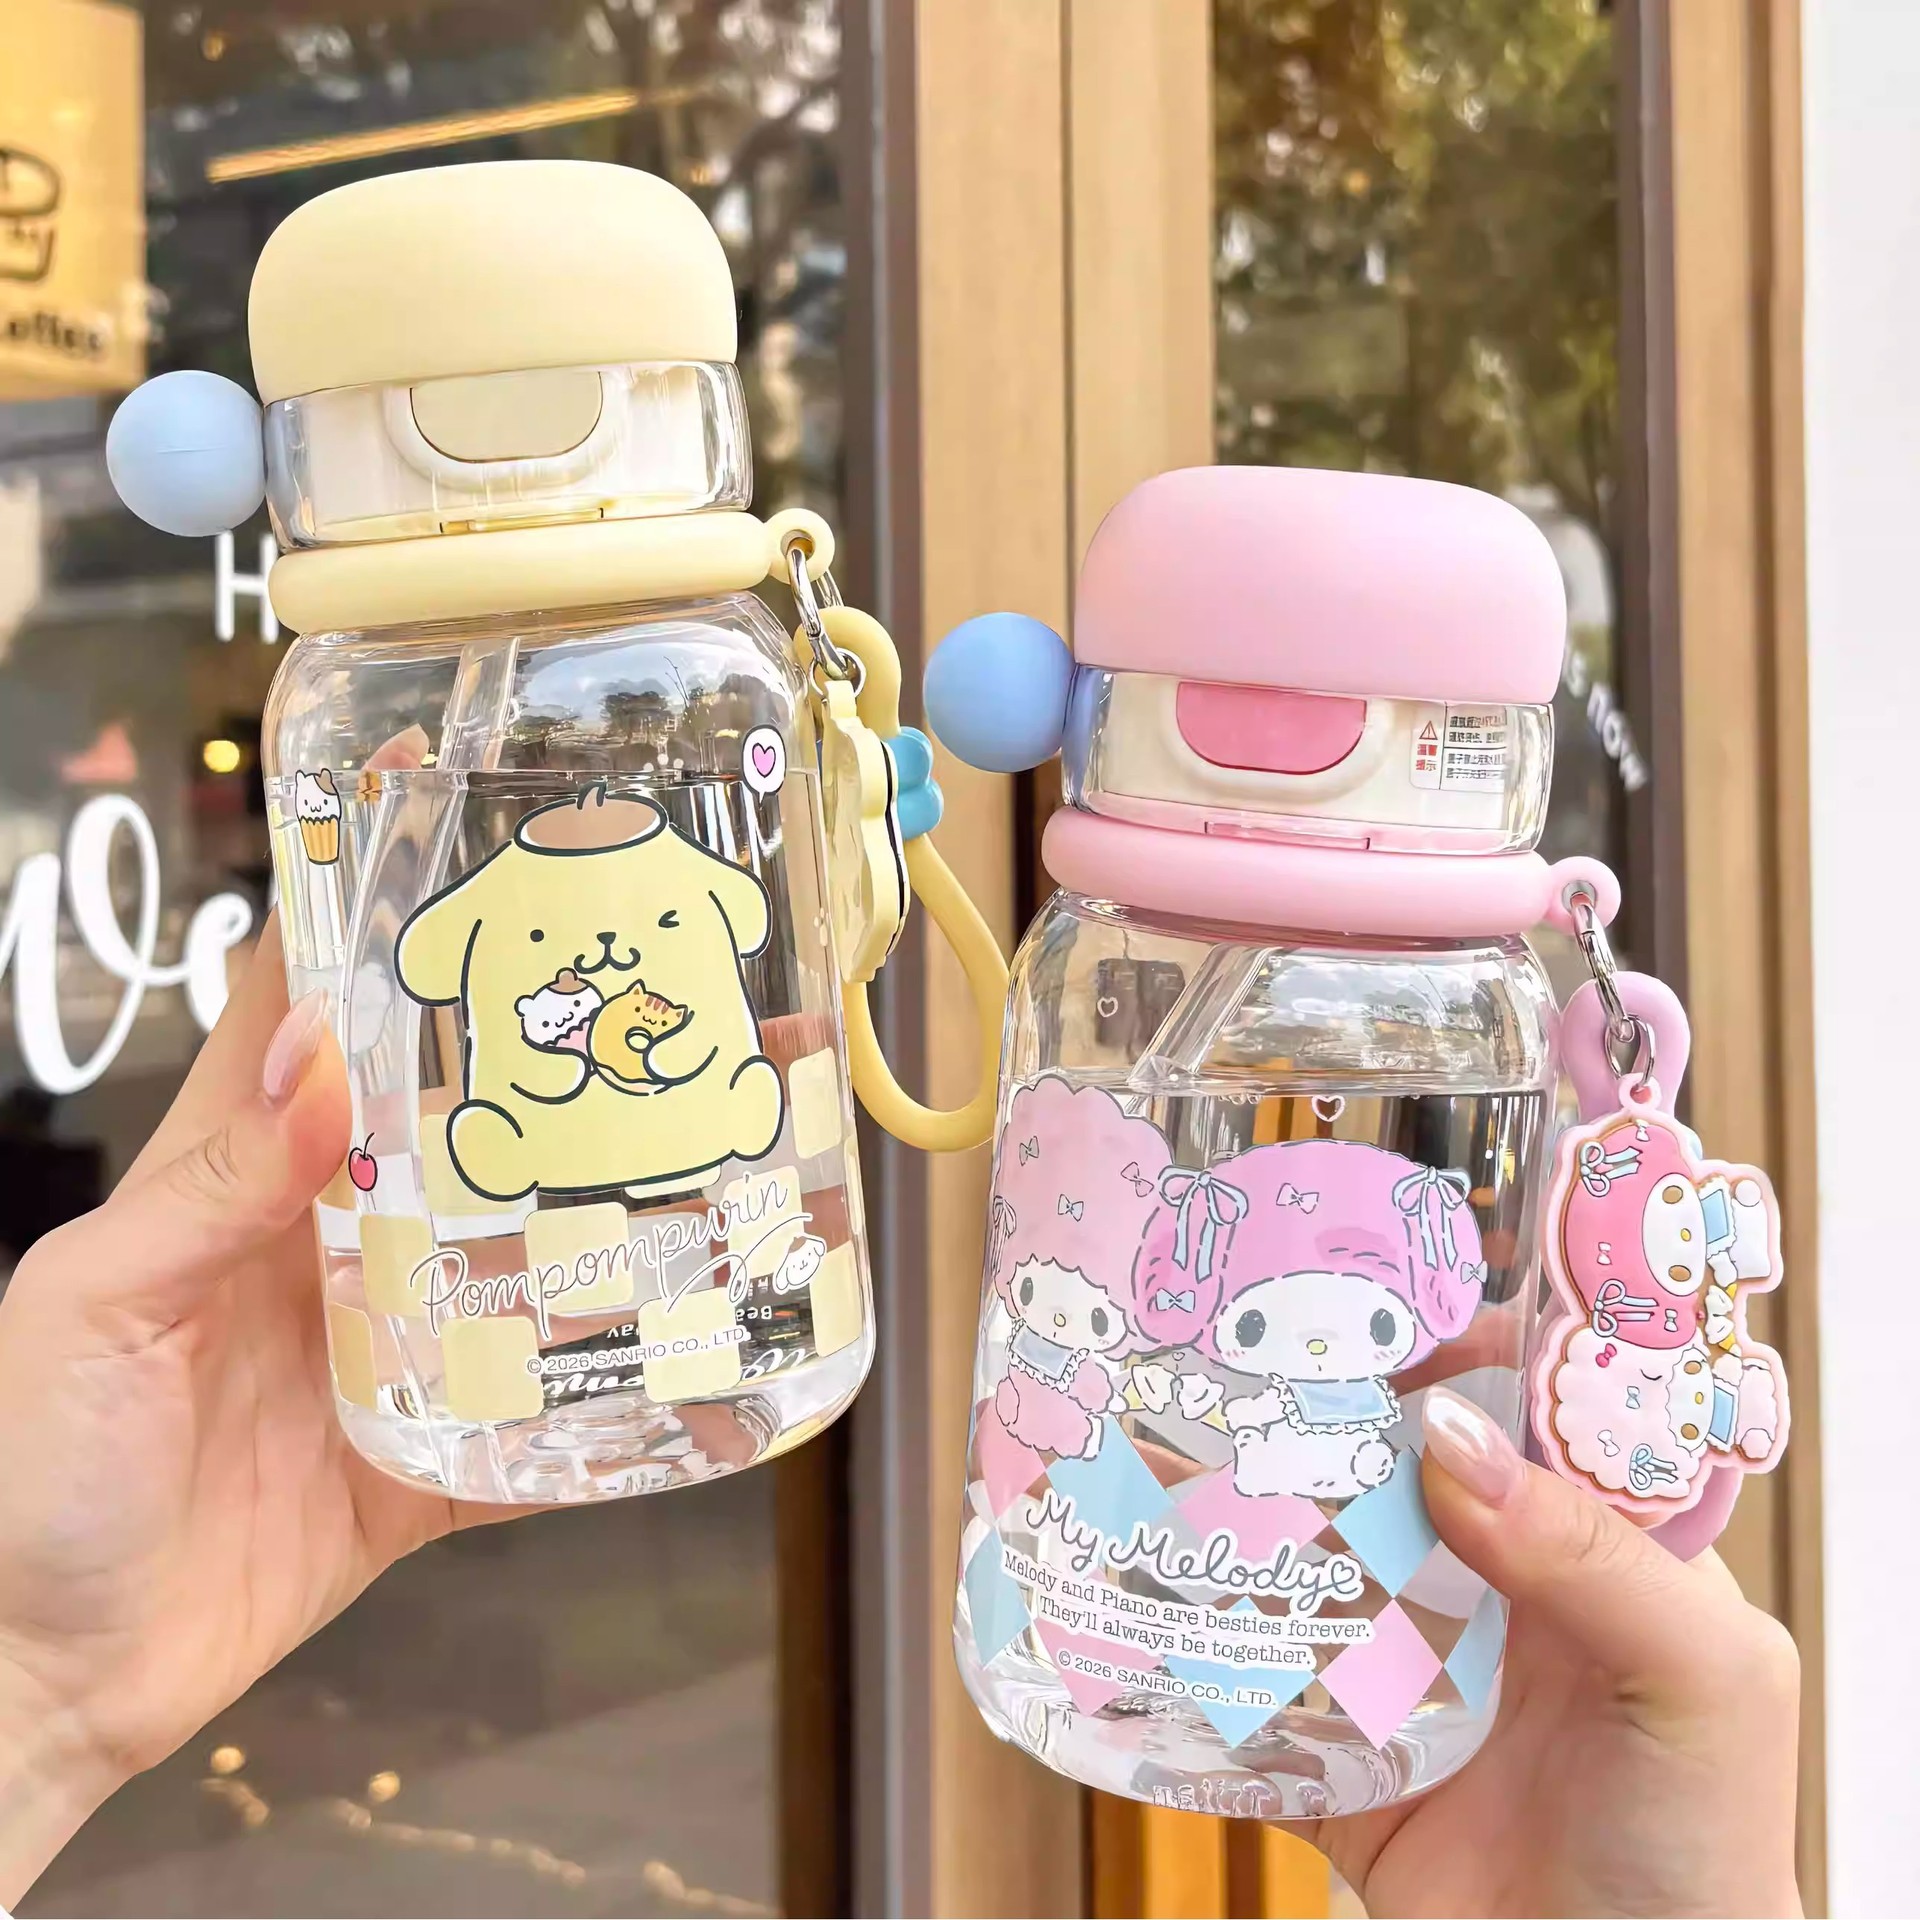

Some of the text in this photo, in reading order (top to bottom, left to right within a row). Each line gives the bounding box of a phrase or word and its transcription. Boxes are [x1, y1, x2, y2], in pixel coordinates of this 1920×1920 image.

[410, 1174, 790, 1340] Pompompurin
[547, 1355, 589, 1372] 2026
[594, 1344, 667, 1366] SANRIO
[672, 1338, 709, 1355] CO.,
[1025, 1494, 1322, 1612] My Melody
[1004, 1550, 1371, 1638] Melody and Piano are besties forever.
[1039, 1594, 1312, 1665] They'll always be together.
[1074, 1656, 1112, 1679] 2026
[1116, 1668, 1187, 1695] SANRIO
[1190, 1684, 1231, 1704] CO.,
[1236, 1690, 1278, 1706] LTD.
